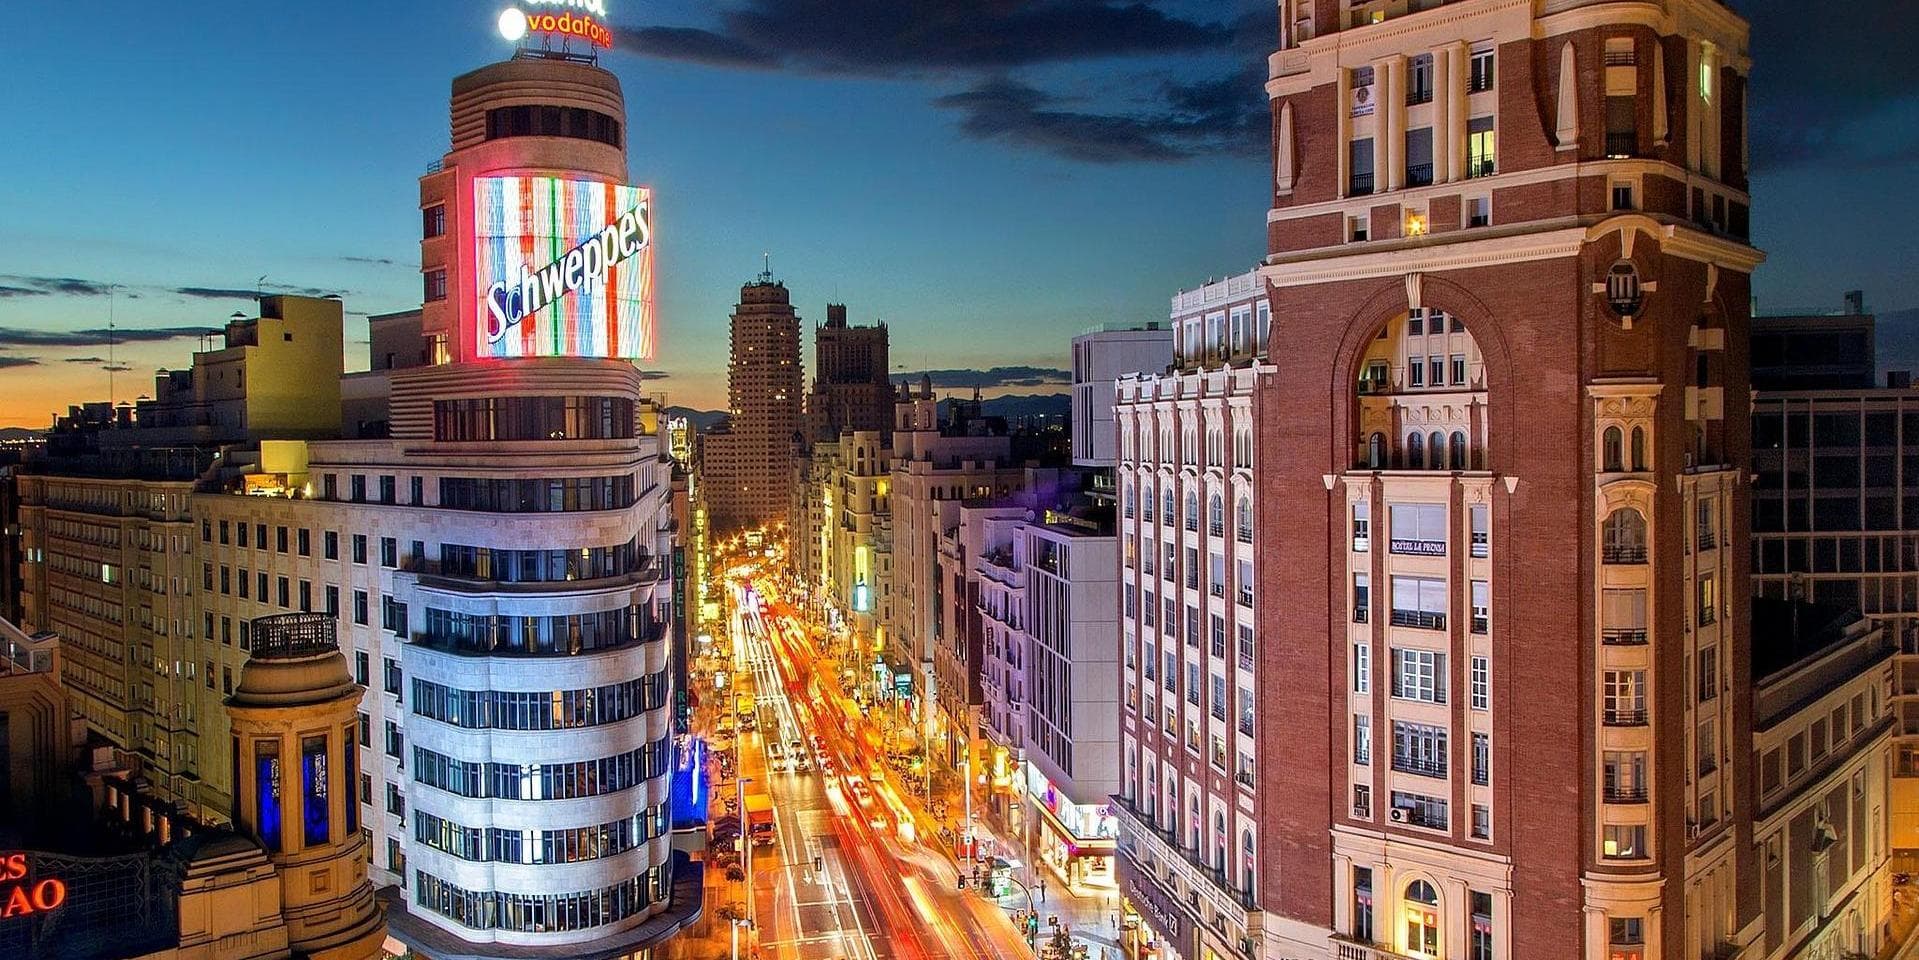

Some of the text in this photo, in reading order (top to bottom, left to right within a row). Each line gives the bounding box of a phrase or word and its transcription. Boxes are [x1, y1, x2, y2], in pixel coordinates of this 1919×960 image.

[527, 12, 611, 47] vodafone
[487, 201, 649, 343] Schweppes
[675, 552, 686, 729] HOTEL REX
